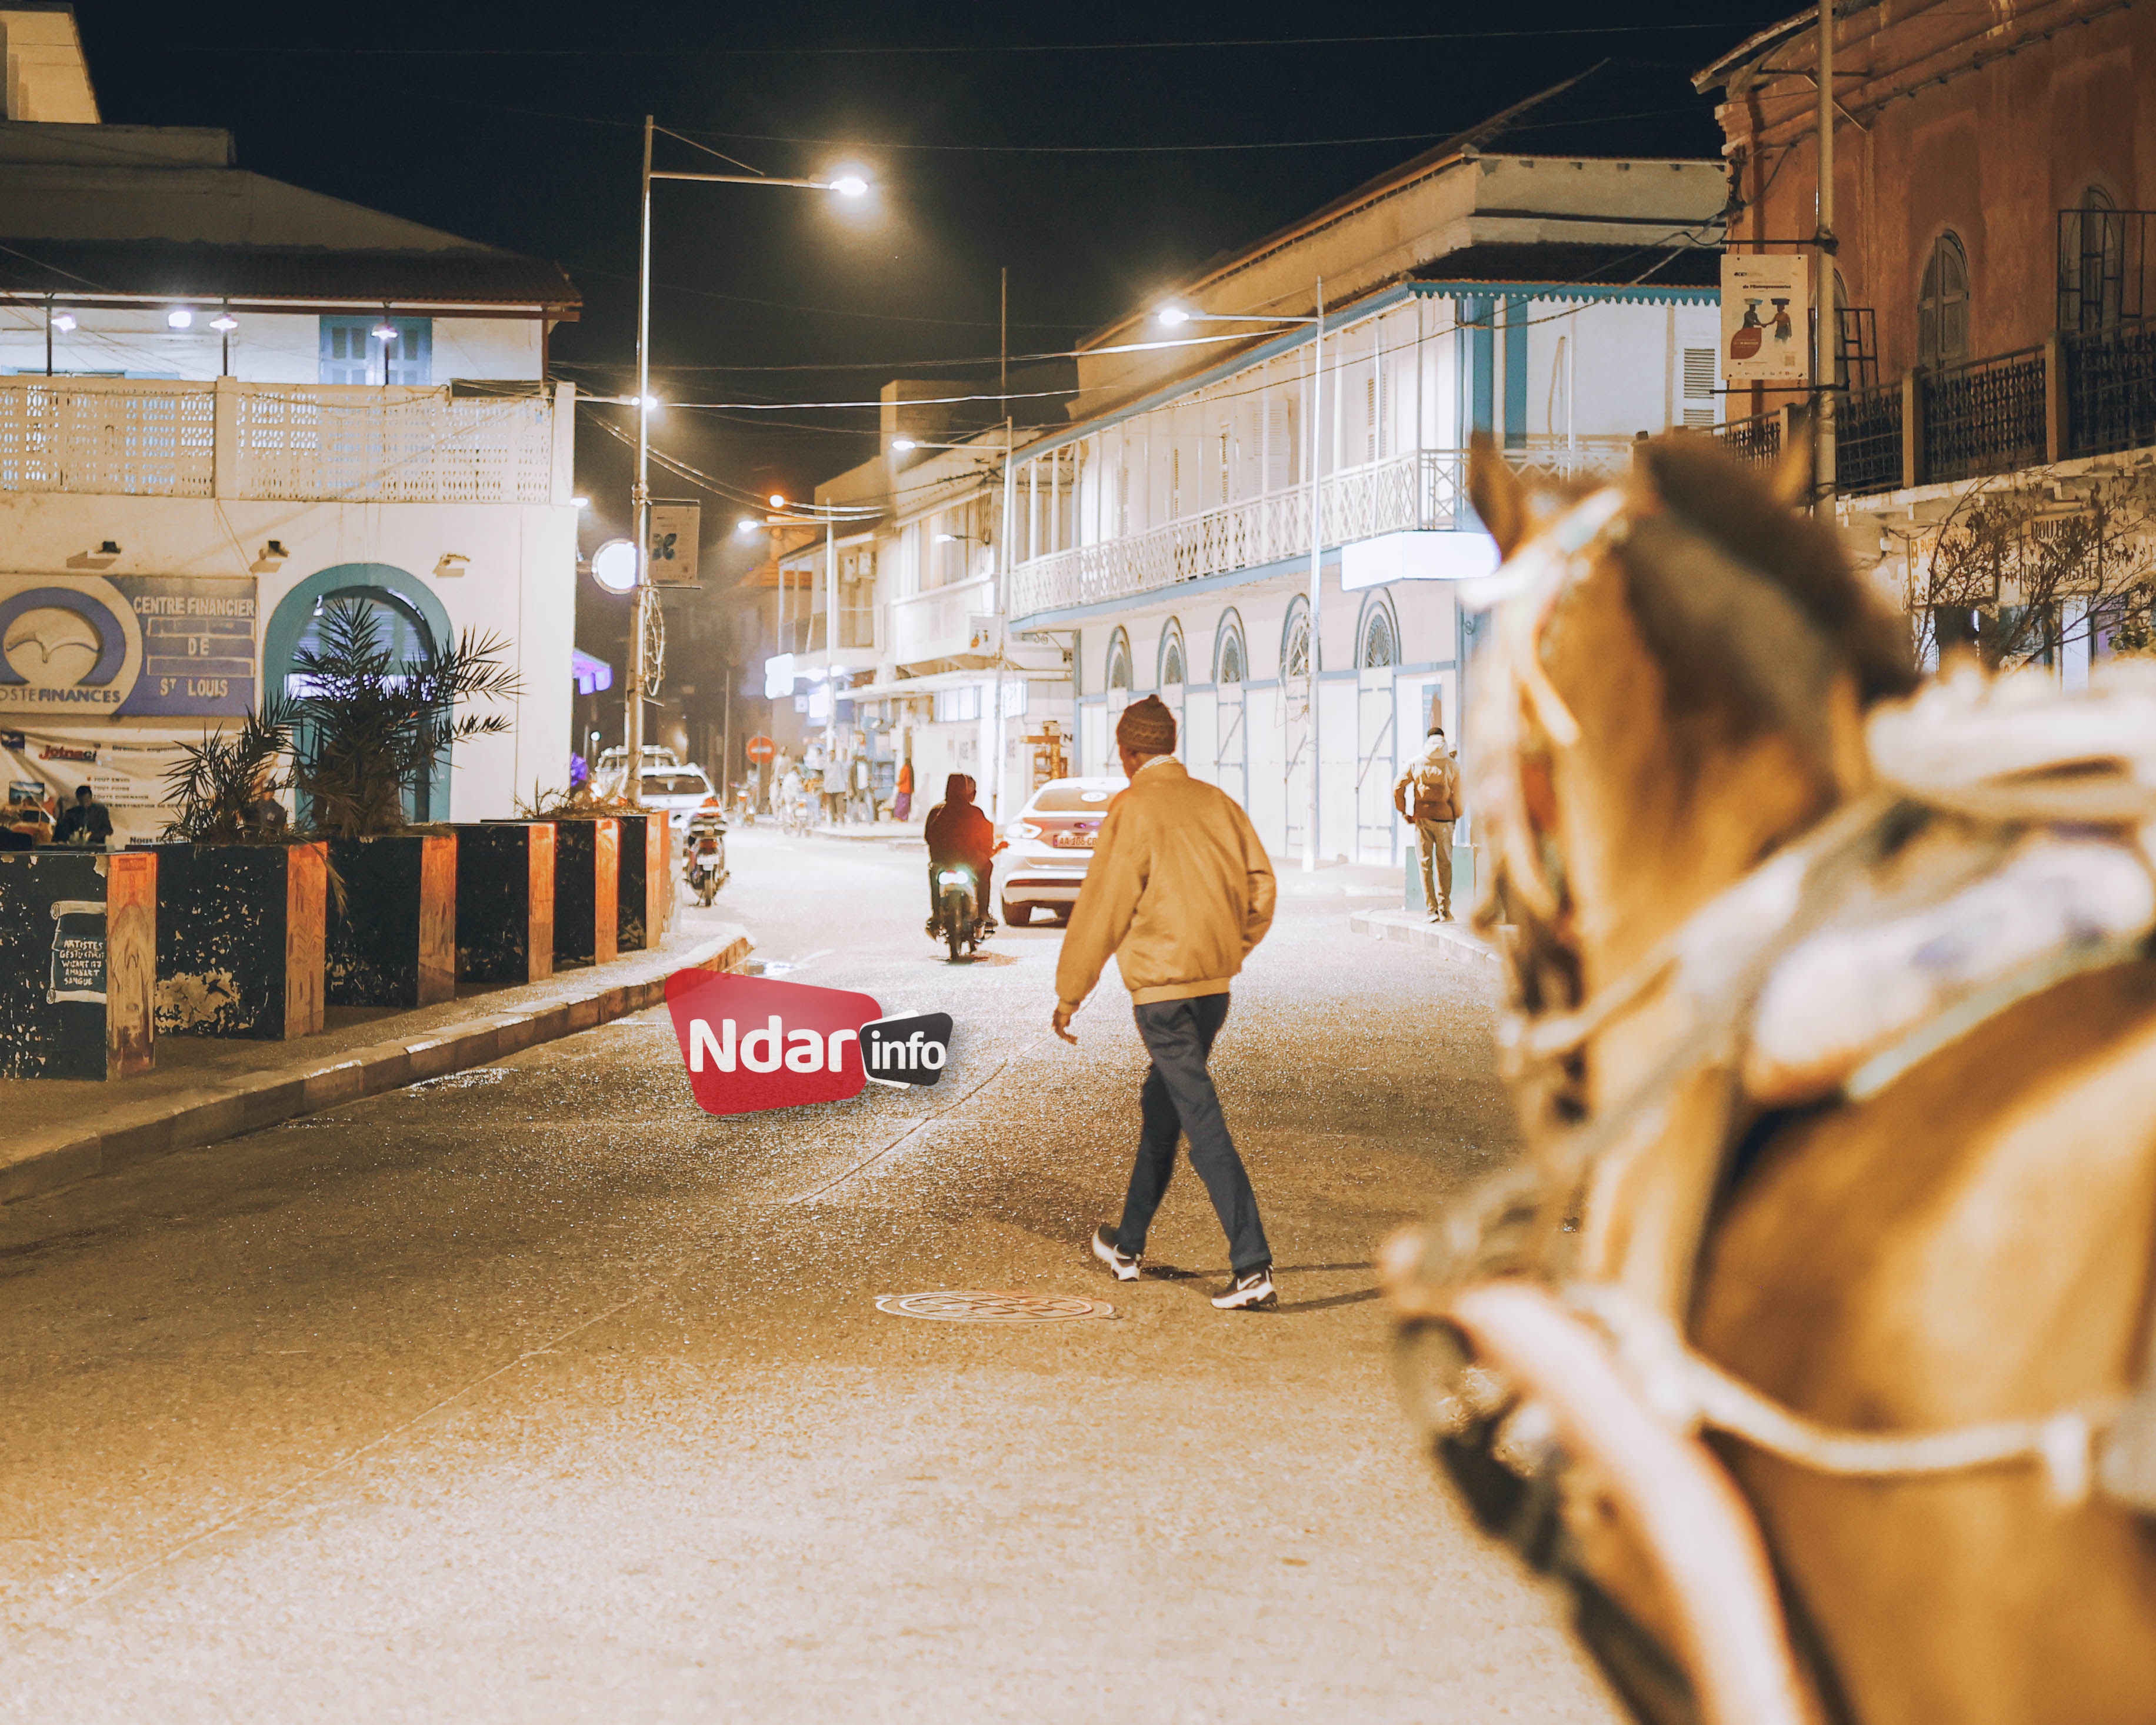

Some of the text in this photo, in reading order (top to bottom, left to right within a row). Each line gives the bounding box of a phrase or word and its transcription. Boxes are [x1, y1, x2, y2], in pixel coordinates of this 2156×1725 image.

[133, 596, 255, 617] CENTRE FINANCIER
[188, 637, 209, 656] DE
[187, 679, 229, 697] LOUIS
[64, 940, 103, 951] ARTISTES
